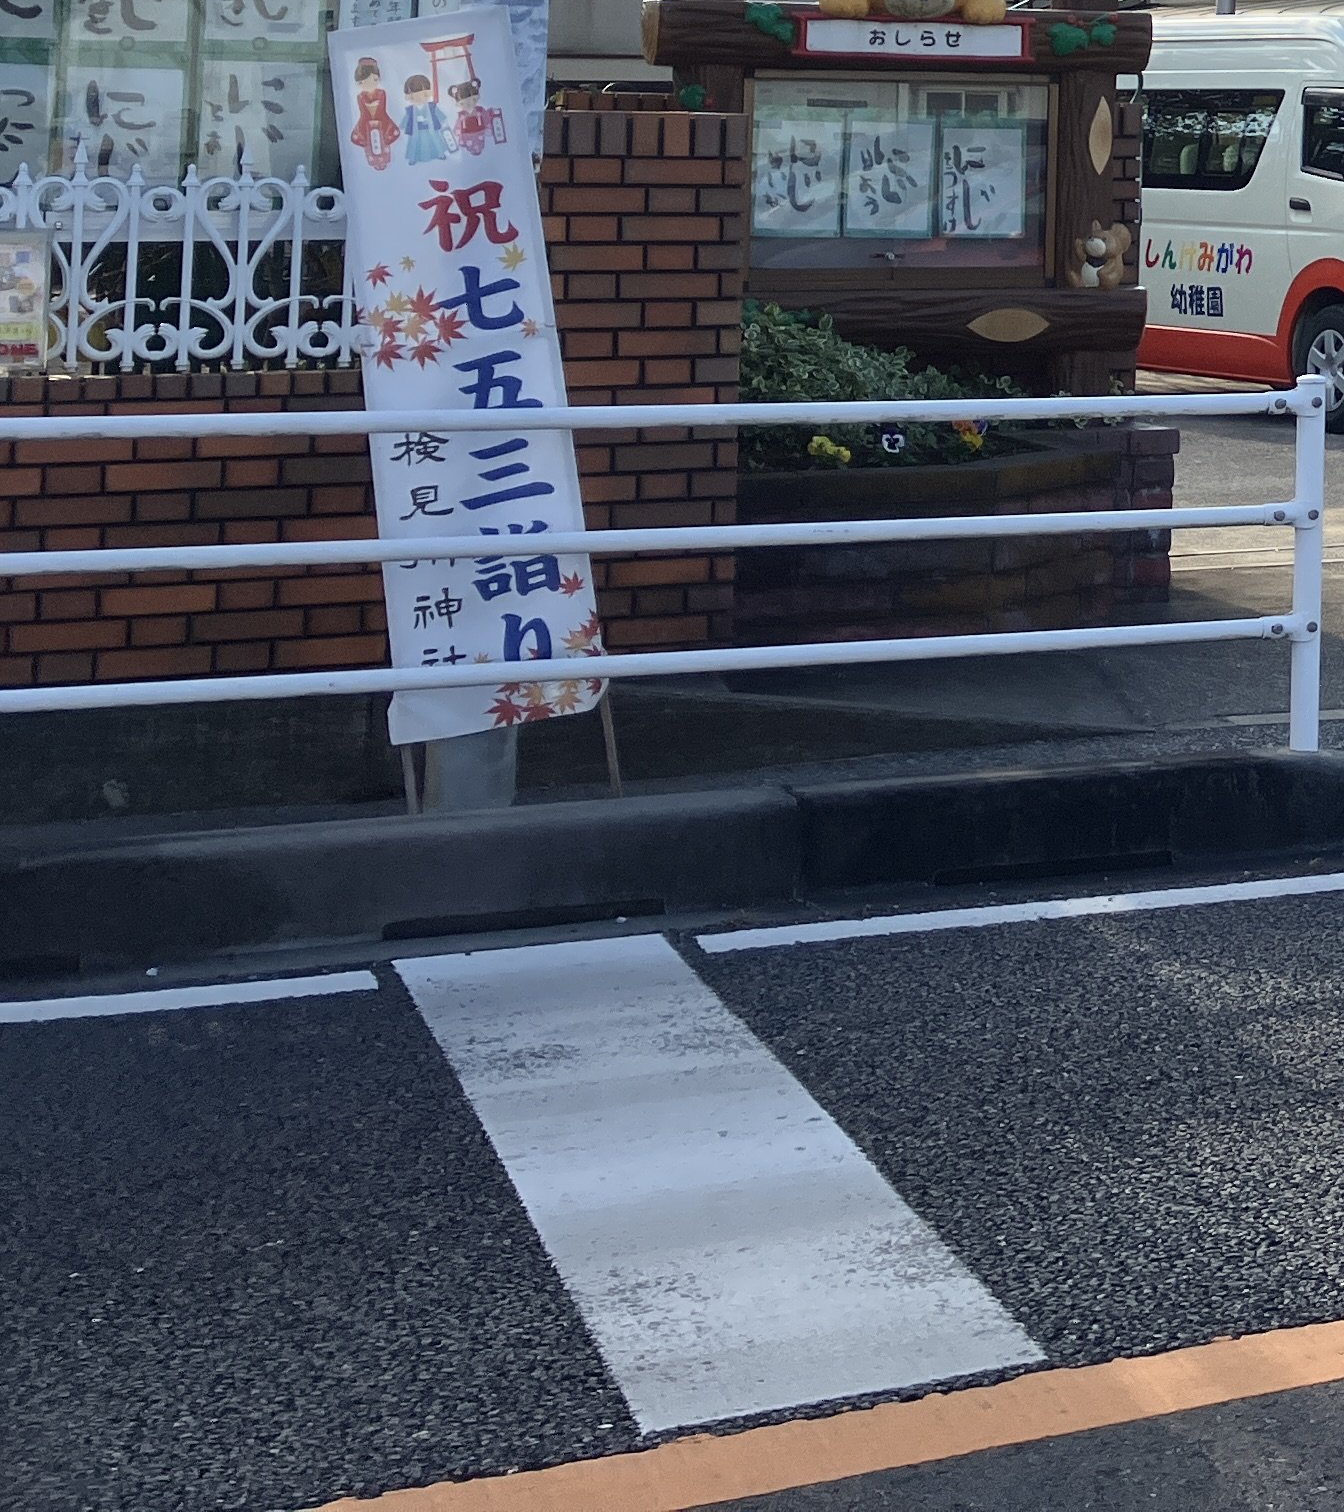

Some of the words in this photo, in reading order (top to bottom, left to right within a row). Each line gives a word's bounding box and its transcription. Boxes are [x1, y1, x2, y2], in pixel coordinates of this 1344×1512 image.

[868, 29, 962, 48] おしらせ
[1144, 238, 1254, 275] しんけみがわ
[1170, 283, 1224, 318] 幼稚園
[390, 432, 467, 667] 検見神
